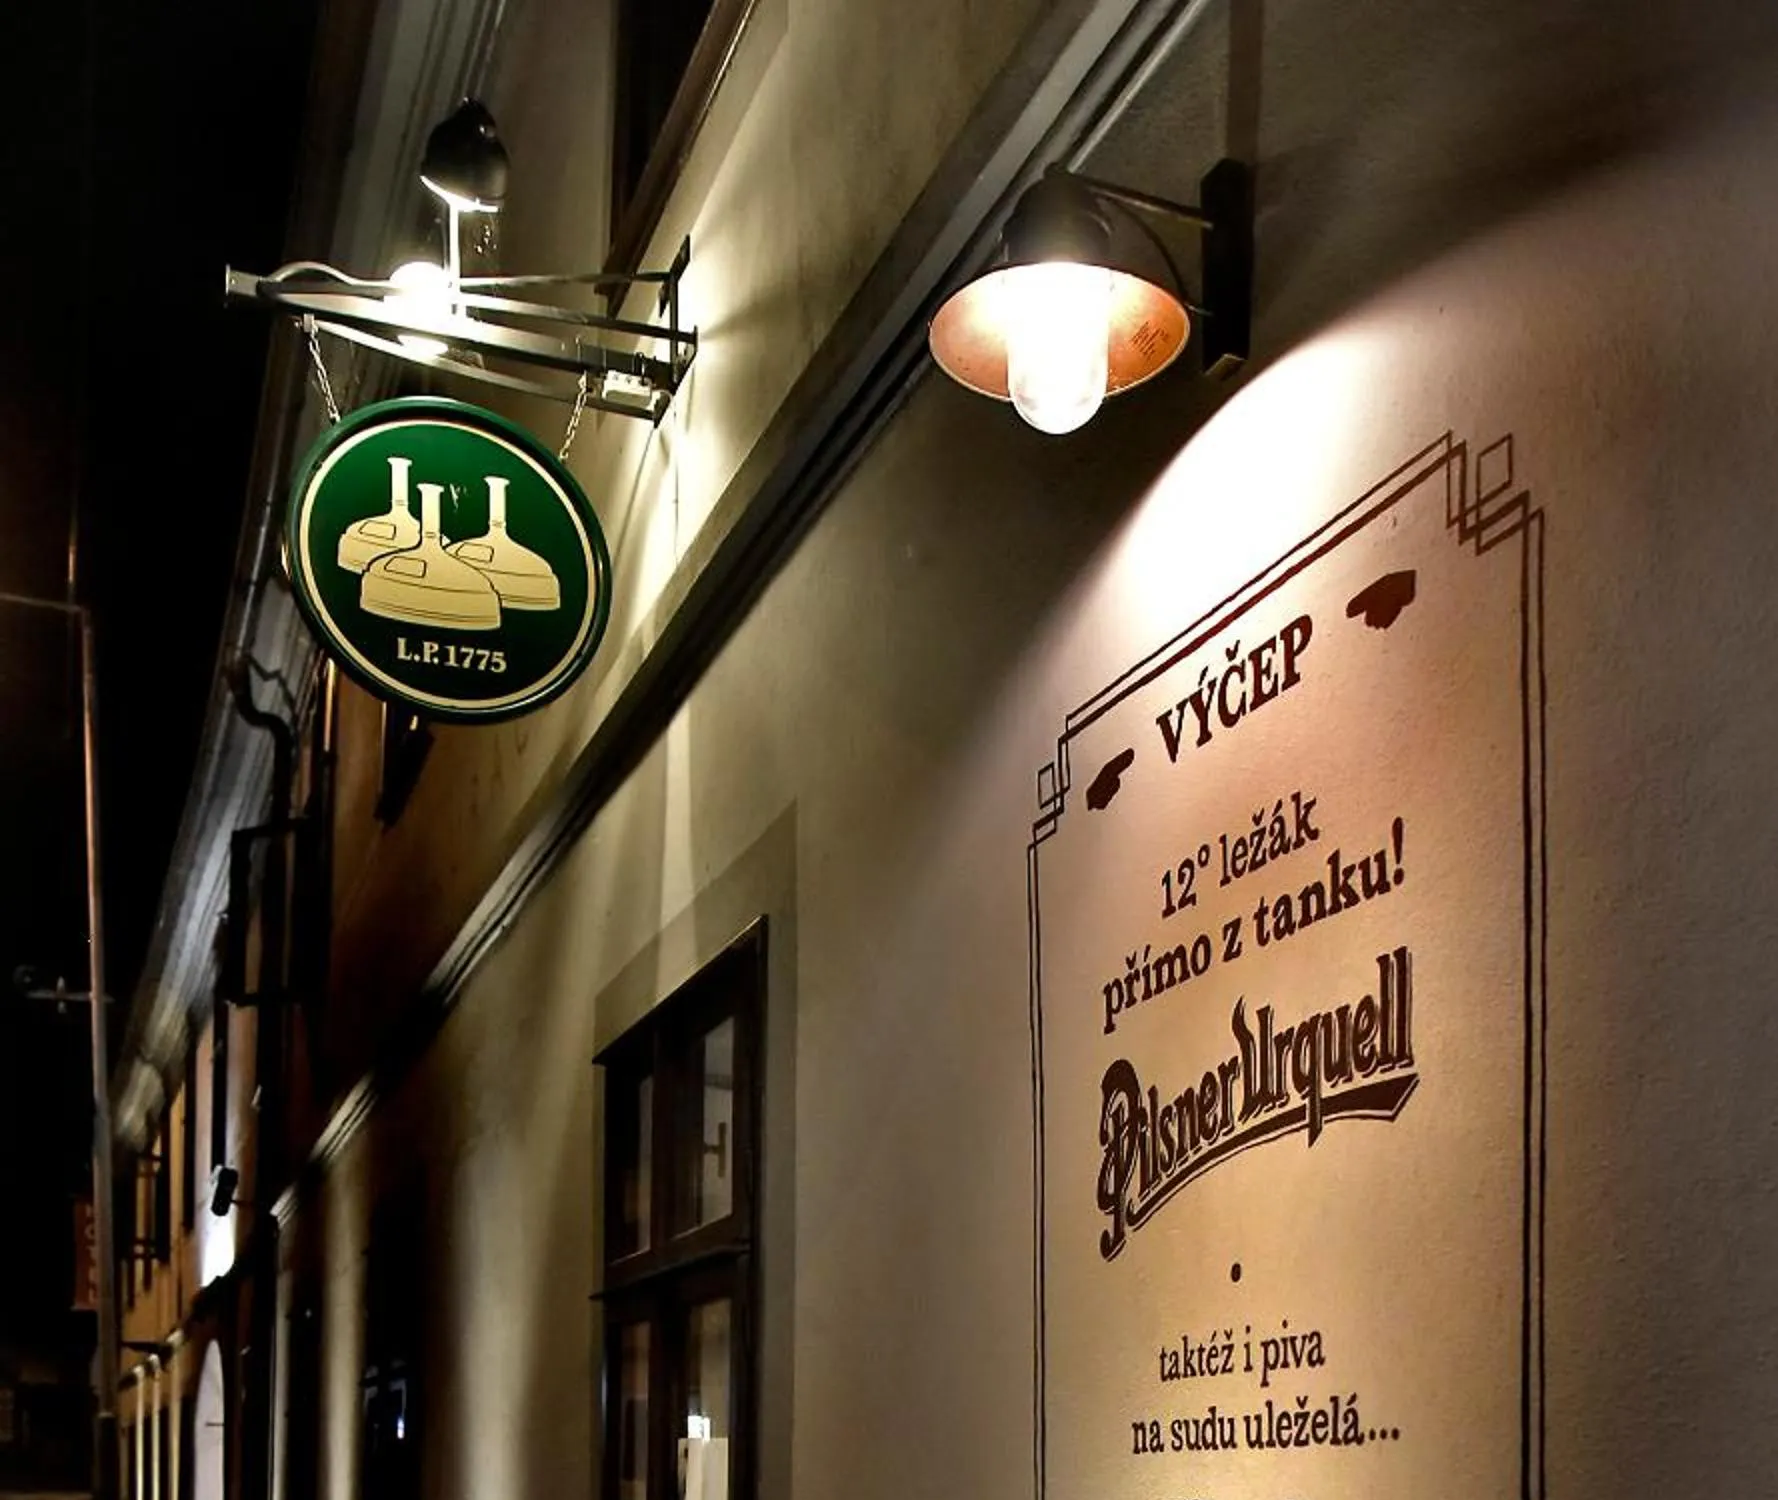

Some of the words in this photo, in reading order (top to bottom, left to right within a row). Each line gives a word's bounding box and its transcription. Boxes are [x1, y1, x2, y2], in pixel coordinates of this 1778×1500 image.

[1156, 614, 1313, 763] VÝČEP
[1219, 790, 1319, 887] ležák
[1103, 945, 1211, 1034] přímo
[1222, 917, 1242, 962] z
[1253, 817, 1405, 946] tanku!
[1097, 1059, 1240, 1262] Pilsner
[1232, 946, 1416, 1148] Urquell
[1159, 1328, 1234, 1382] taktéž
[1243, 1325, 1253, 1372] i
[1260, 1319, 1325, 1387] piva
[1132, 1418, 1165, 1454] na
[1171, 1406, 1237, 1451] sudu
[1243, 1392, 1400, 1449] uleželá...
